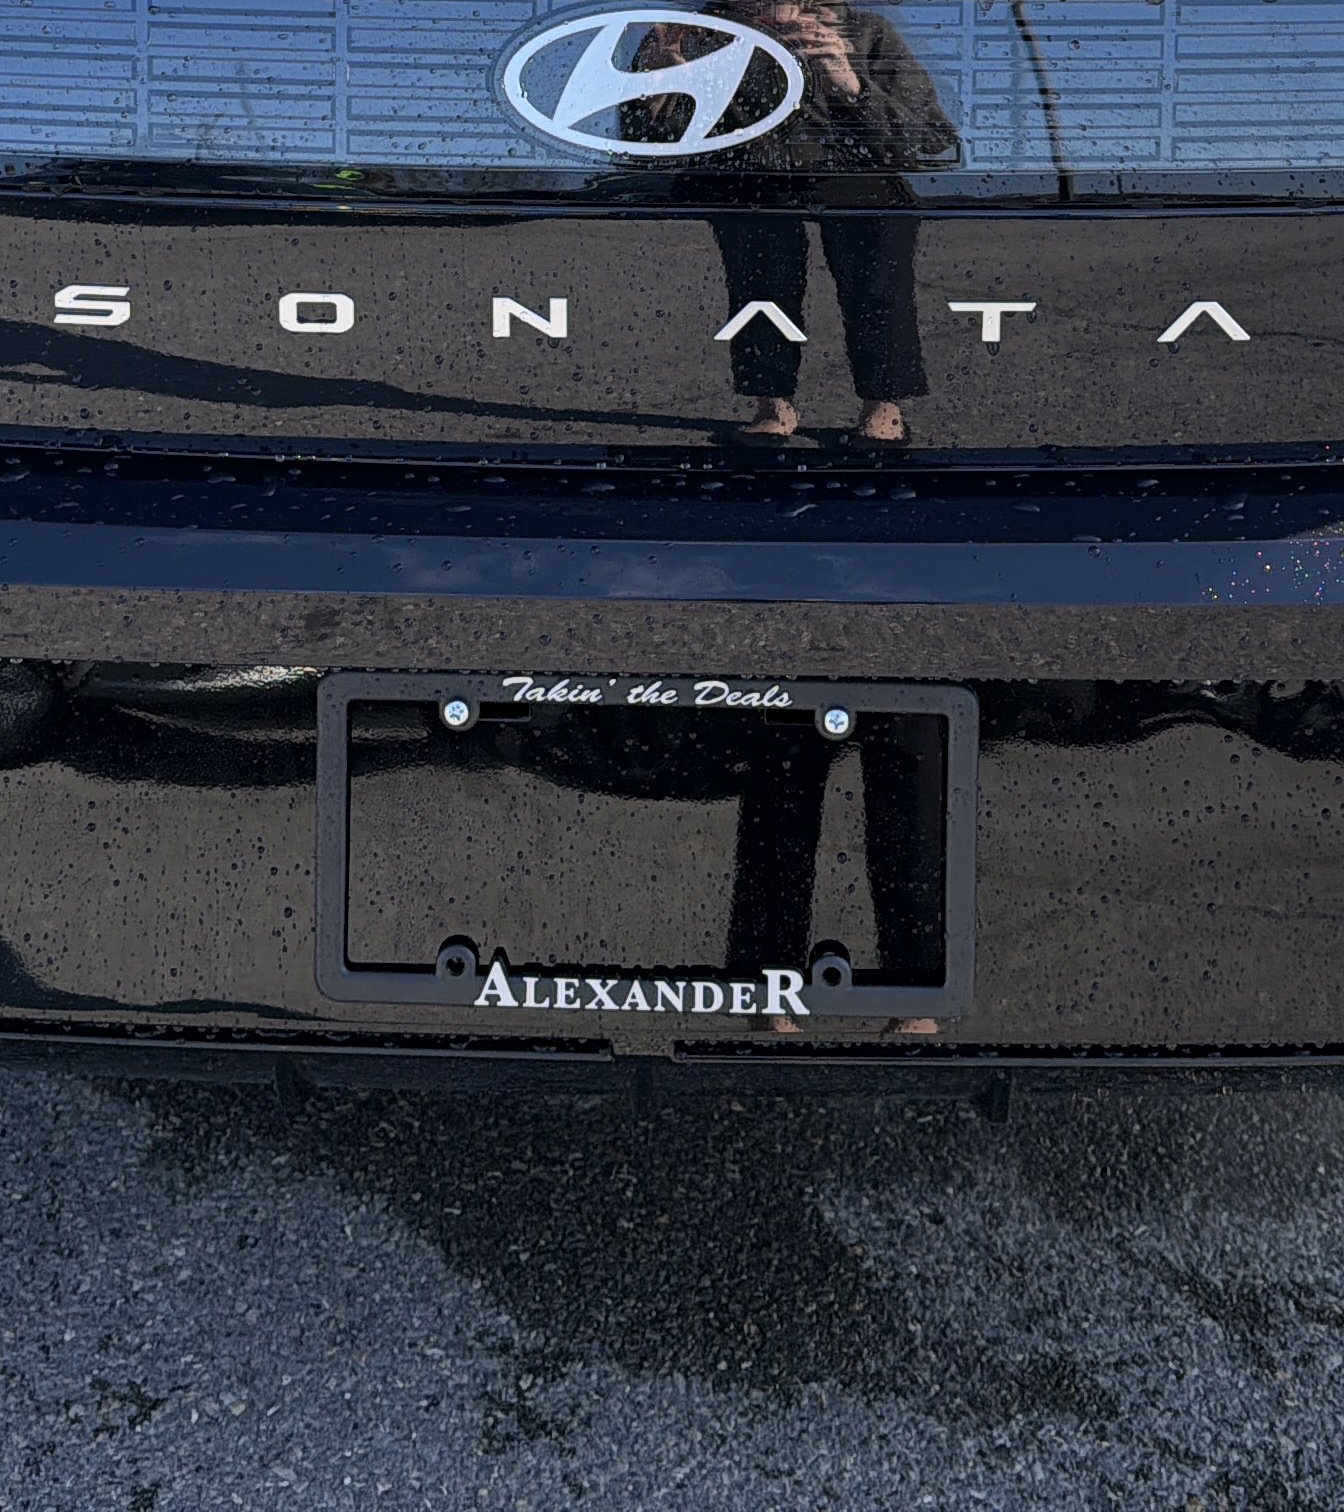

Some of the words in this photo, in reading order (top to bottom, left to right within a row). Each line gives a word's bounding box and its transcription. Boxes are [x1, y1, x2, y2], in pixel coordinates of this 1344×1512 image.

[502, 676, 617, 703] Takin'
[626, 680, 678, 705] the
[693, 679, 794, 708] Deals
[473, 960, 811, 1016] ALEXANDER
